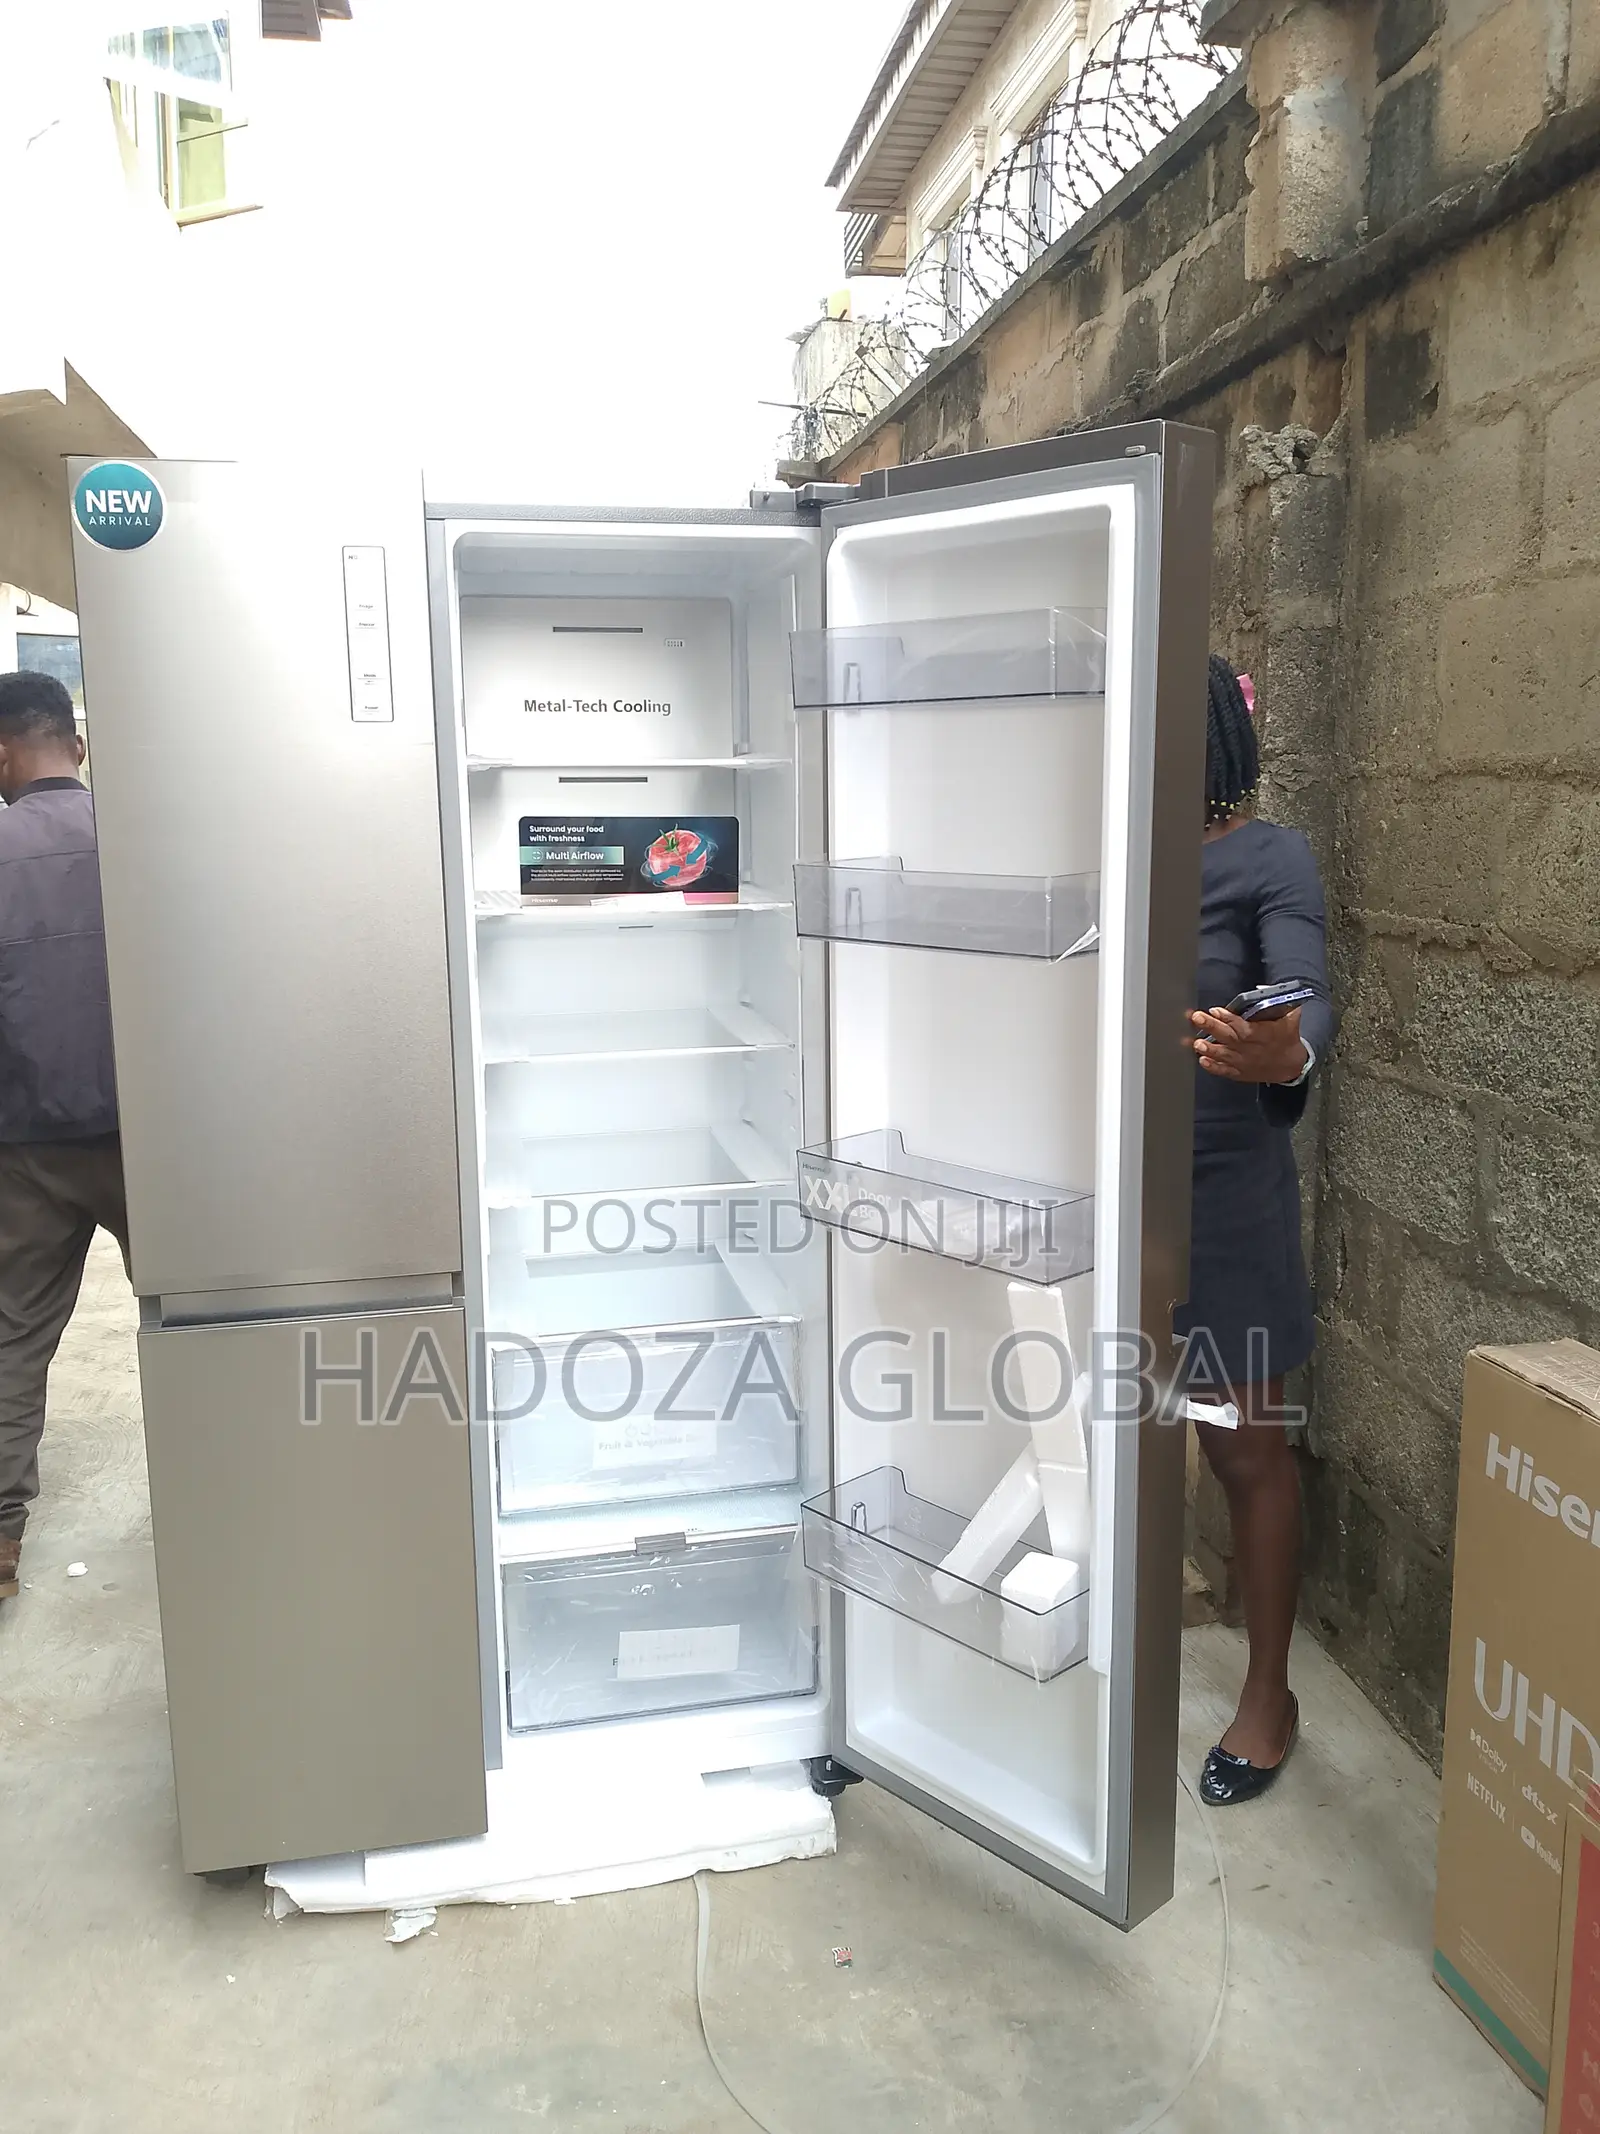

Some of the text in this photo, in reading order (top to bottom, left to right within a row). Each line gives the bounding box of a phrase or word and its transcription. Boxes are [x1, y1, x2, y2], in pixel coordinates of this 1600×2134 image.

[85, 489, 152, 514] NEW
[89, 516, 151, 527] ARRIVAL
[524, 699, 672, 716] Metal-Tech Cooling
[529, 825, 604, 835] Surround your food
[529, 834, 586, 842] with freshness
[546, 851, 605, 860] Multi Airflow
[1474, 1637, 1600, 1792] UHD
[1481, 1739, 1508, 1773] Dolby
[1466, 1772, 1507, 1824] NETFLIX
